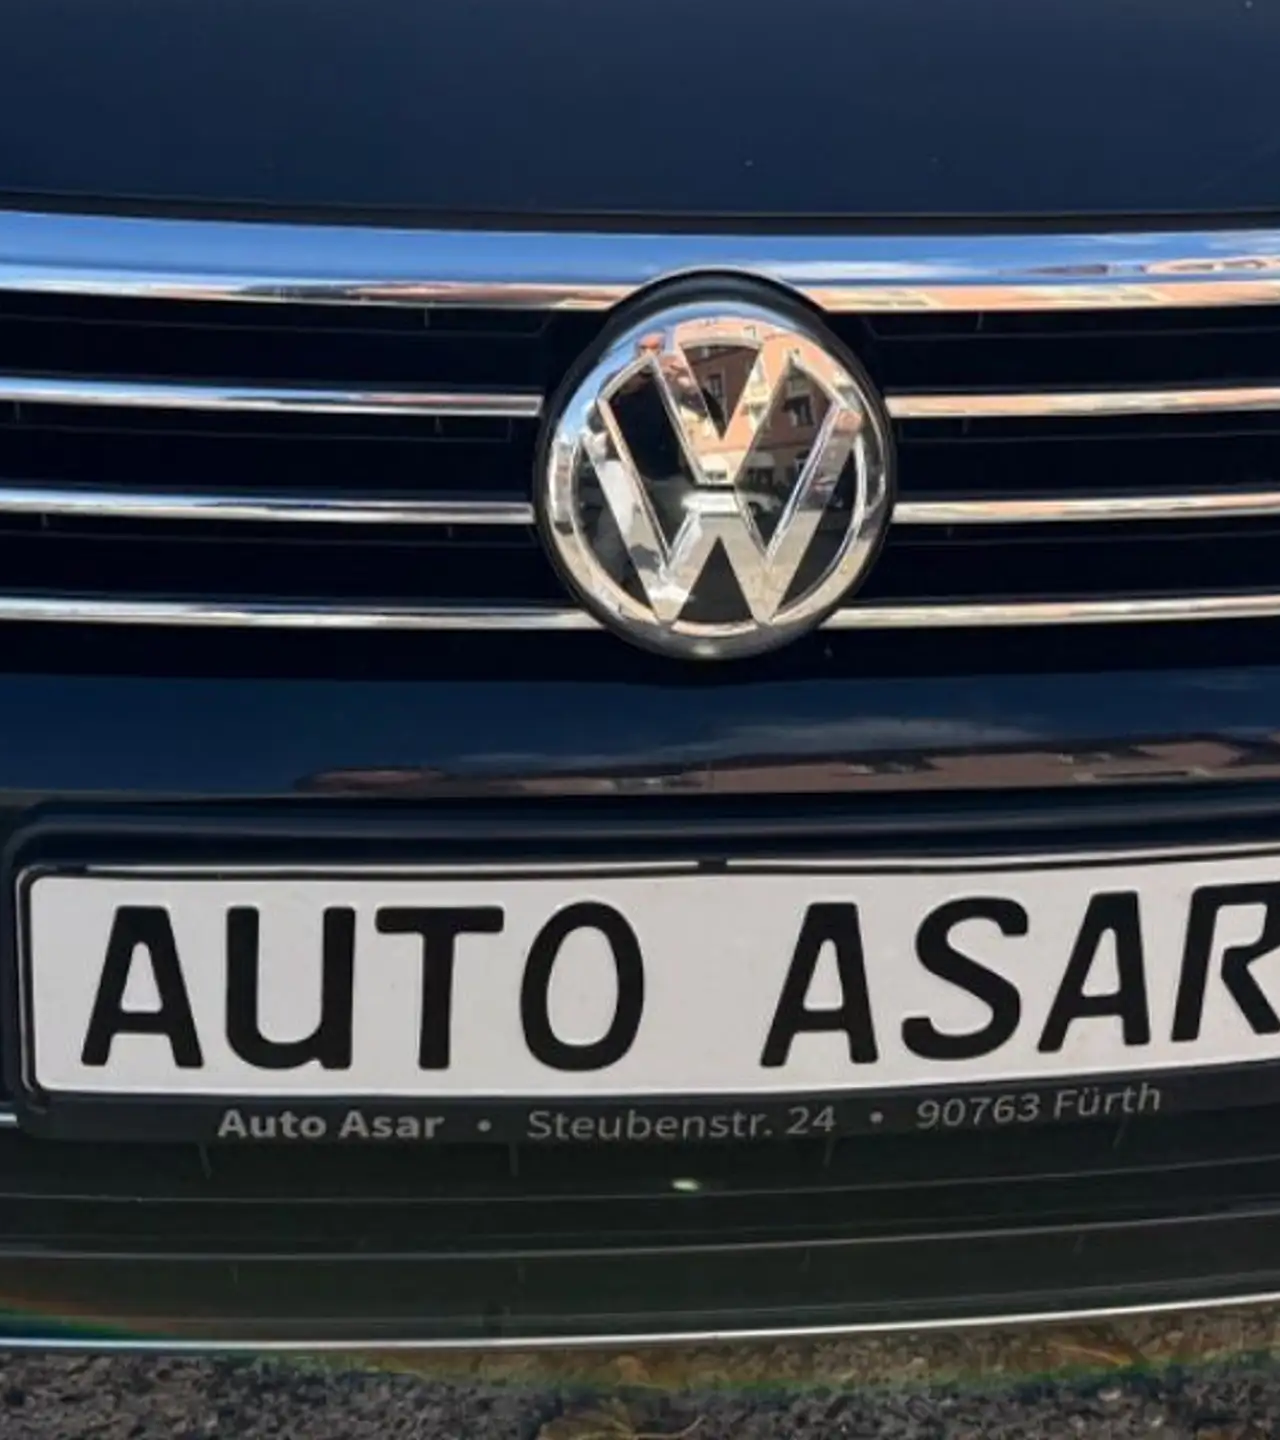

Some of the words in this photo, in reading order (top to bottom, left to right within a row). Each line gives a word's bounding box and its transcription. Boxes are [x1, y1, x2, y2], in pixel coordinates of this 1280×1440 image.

[555, 305, 880, 650] VW
[79, 900, 645, 1072] AUTO
[217, 1108, 327, 1140] Auto
[337, 1109, 445, 1140] Asar
[526, 1105, 774, 1140] Steubenstr.
[785, 1105, 837, 1135] 24
[915, 1094, 1042, 1130] 90763
[1053, 1082, 1162, 1120] Fürth
